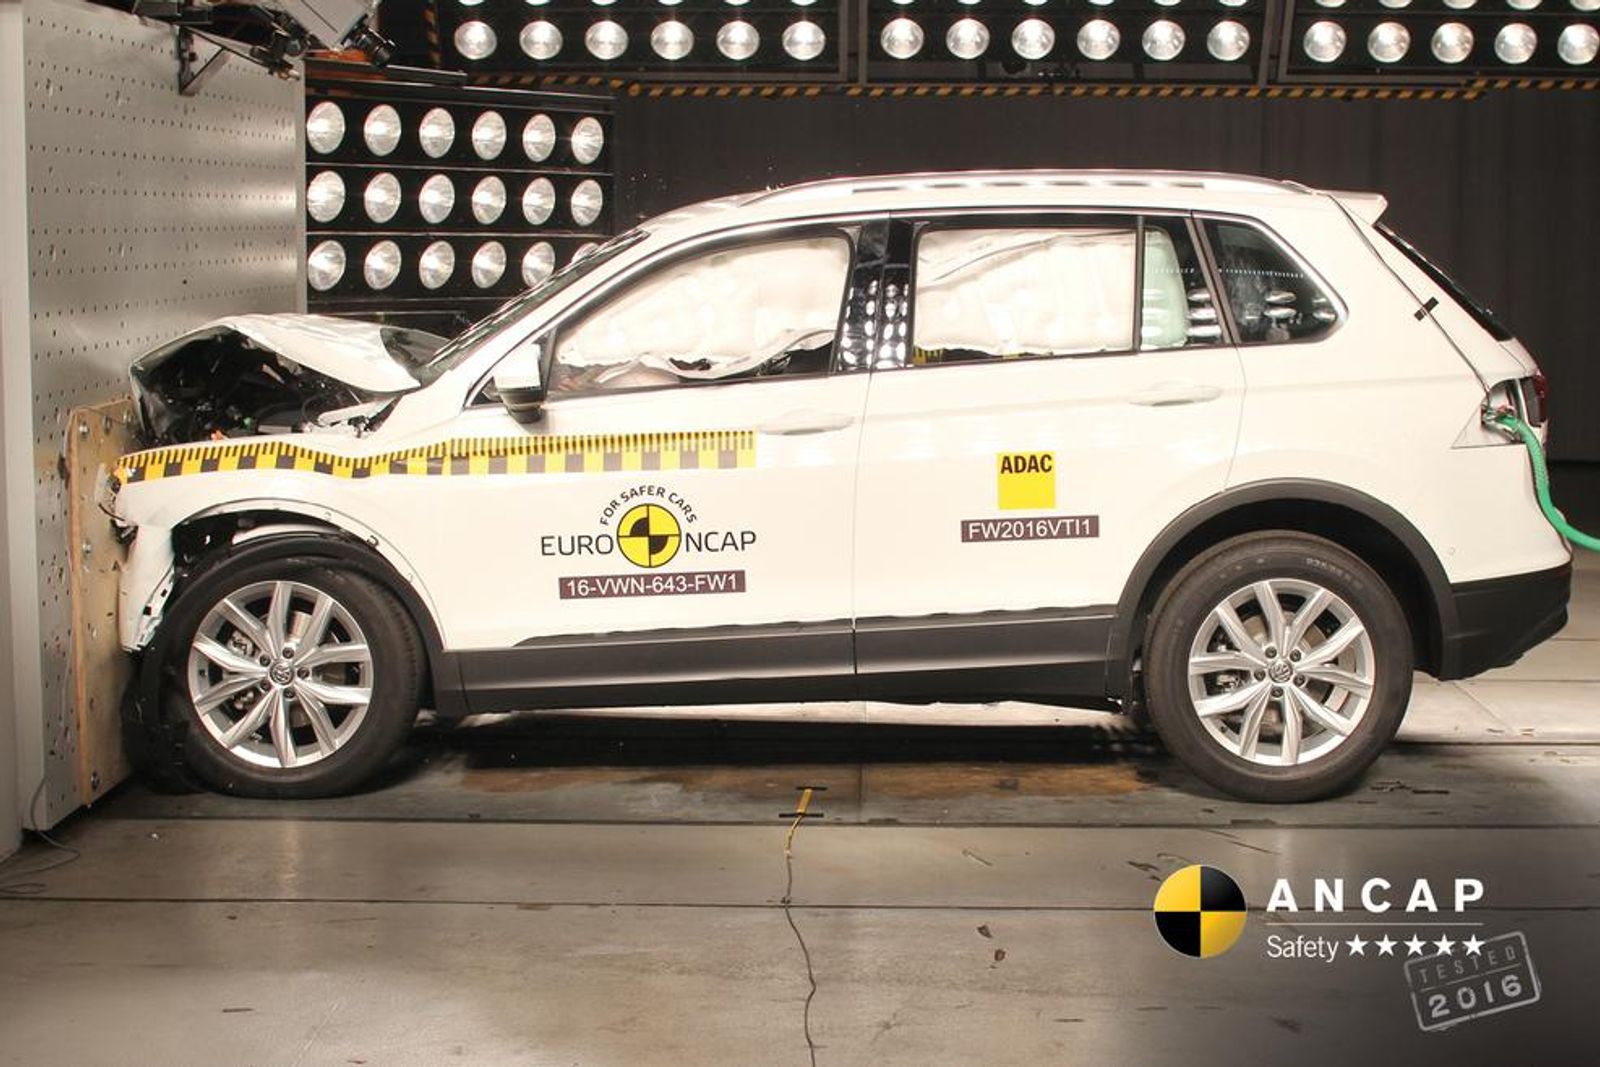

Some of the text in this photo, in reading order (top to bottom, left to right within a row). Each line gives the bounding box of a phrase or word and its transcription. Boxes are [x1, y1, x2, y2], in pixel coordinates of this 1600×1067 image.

[1000, 454, 1052, 474] ADAC
[600, 485, 698, 526] FOR SAFER CARS
[968, 518, 1090, 540] FW2016VTI1
[541, 531, 757, 556] EURO NCAP
[566, 573, 738, 597] 16-VWN-643-FW1
